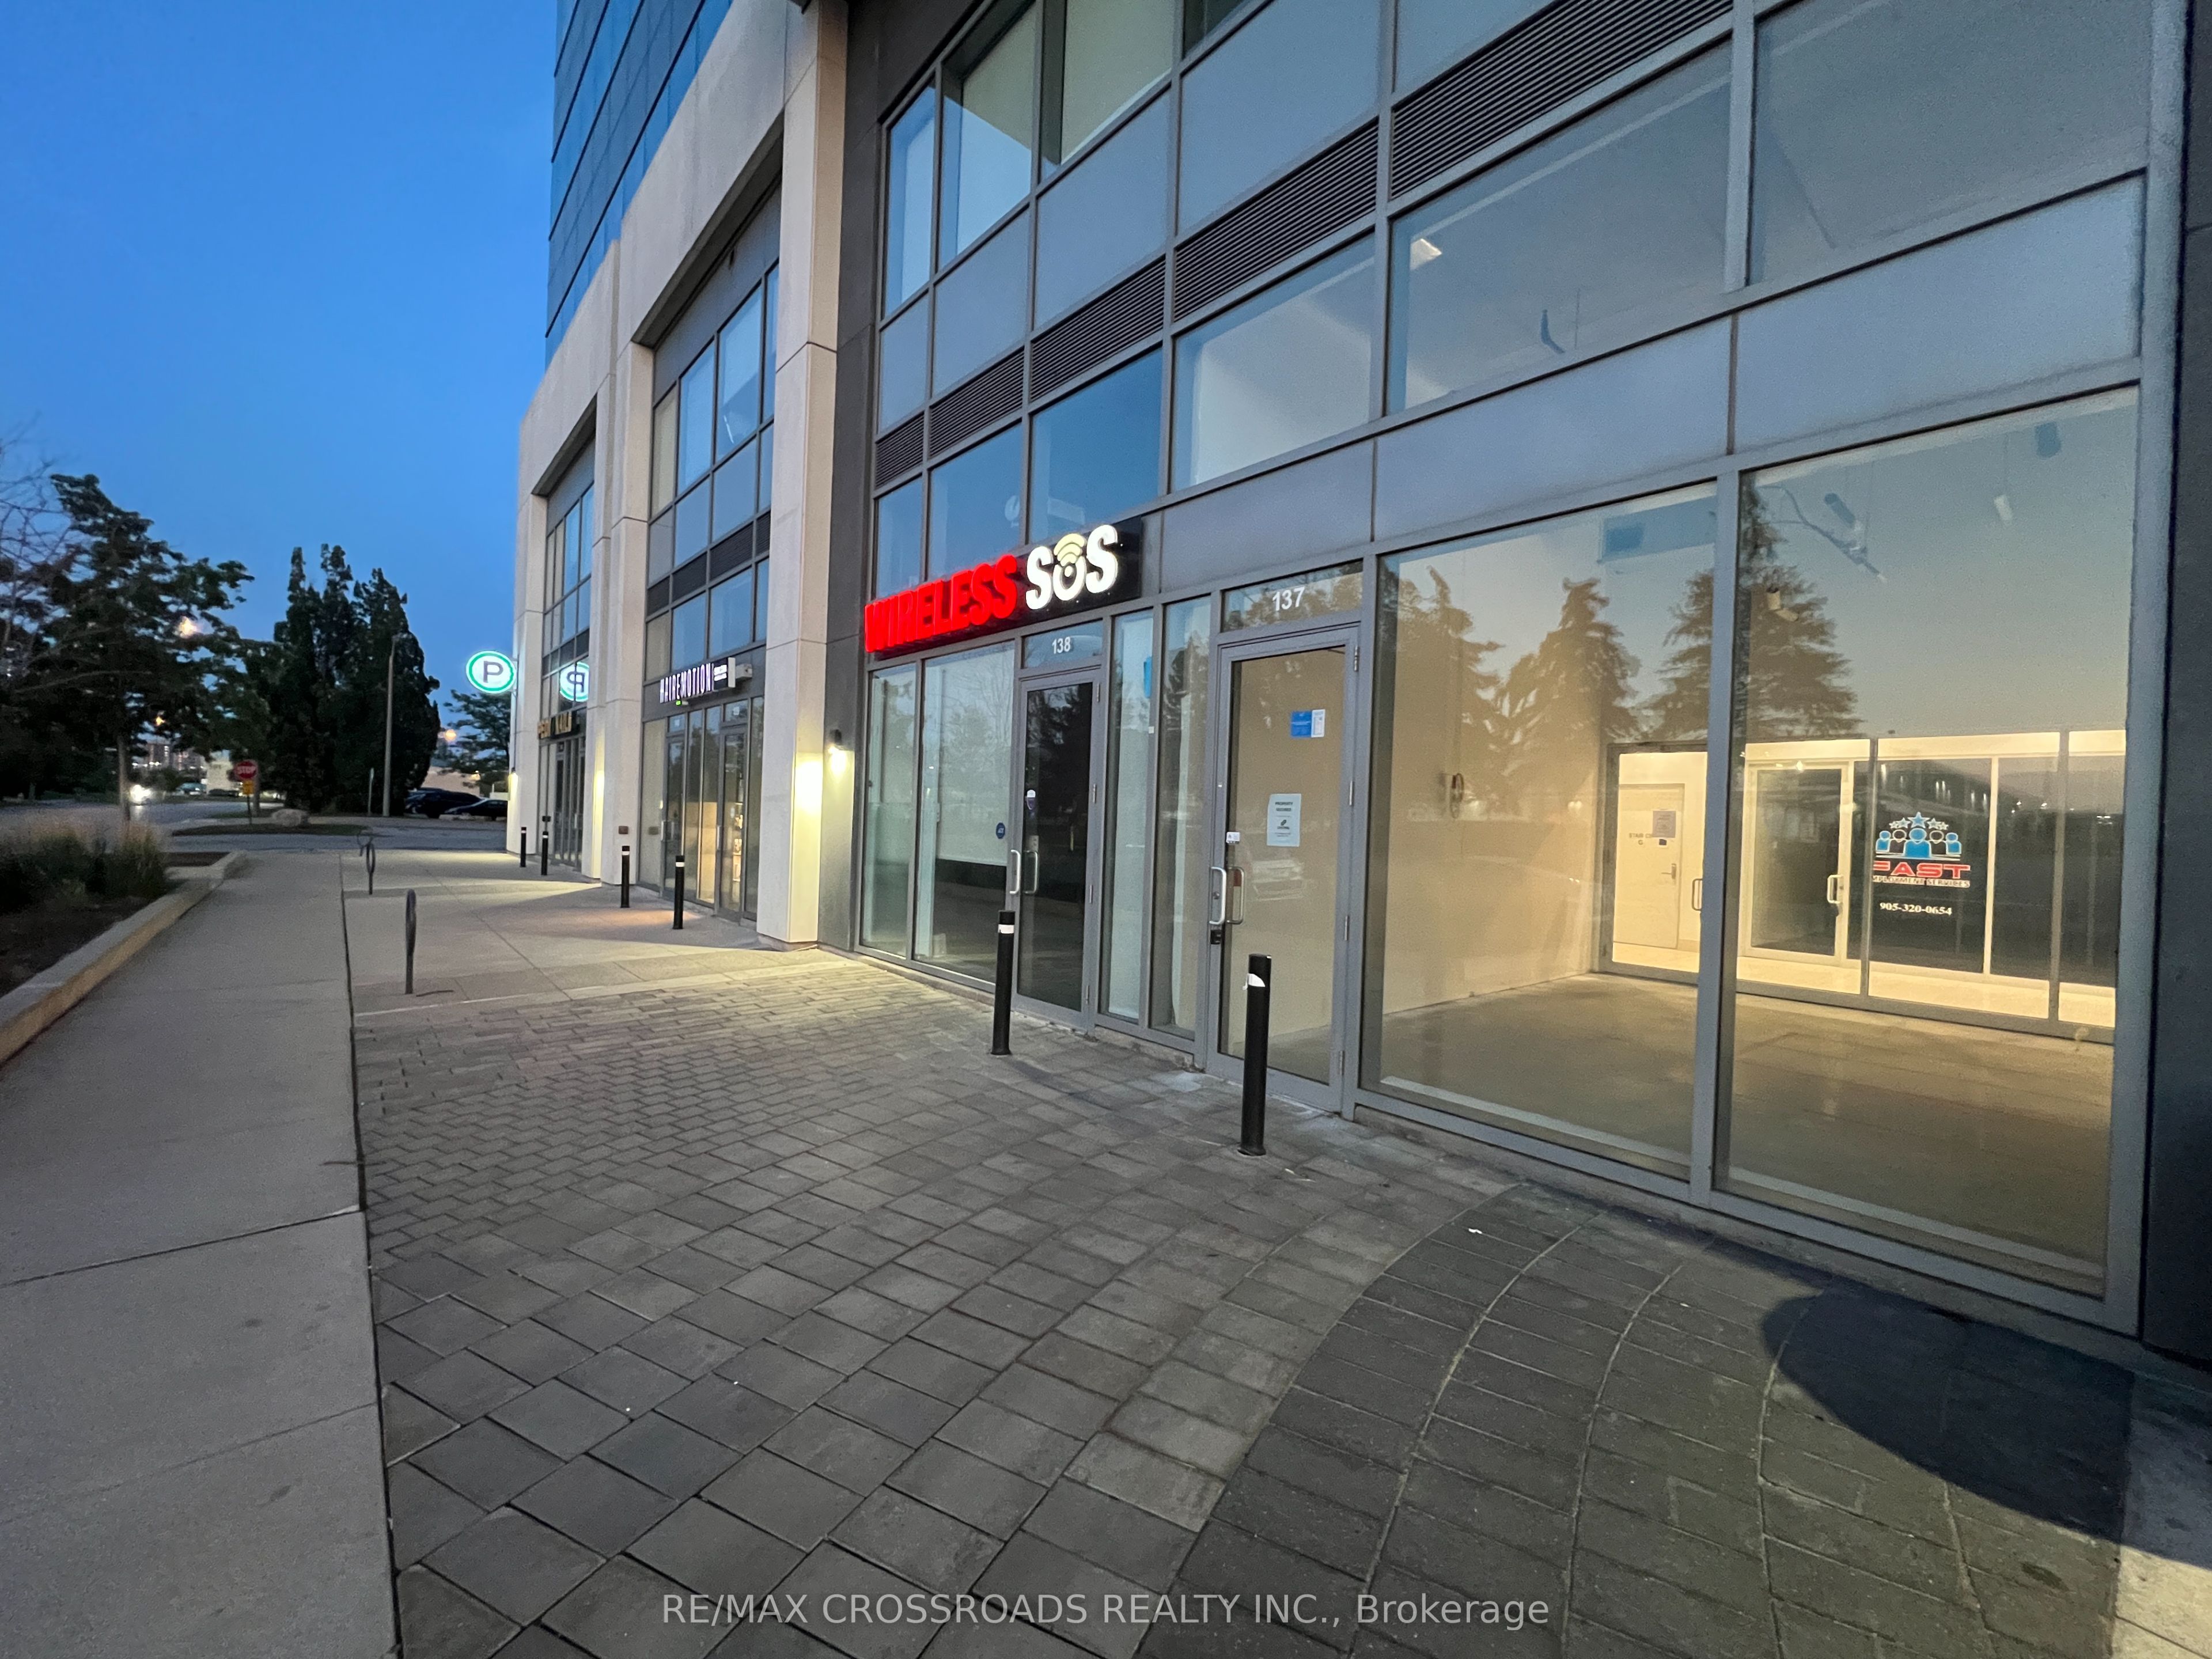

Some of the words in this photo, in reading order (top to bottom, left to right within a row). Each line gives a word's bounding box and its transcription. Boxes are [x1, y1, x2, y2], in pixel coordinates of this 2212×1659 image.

[865, 554, 1017, 653] WIRELESS
[1026, 524, 1118, 609] SOS
[1272, 586, 1305, 611] 137
[1052, 637, 1071, 654] 138
[483, 661, 503, 683] P
[237, 766, 256, 774] STOP
[1926, 878, 1971, 888] SERVICES
[1880, 902, 1952, 916] 905-320-0654
